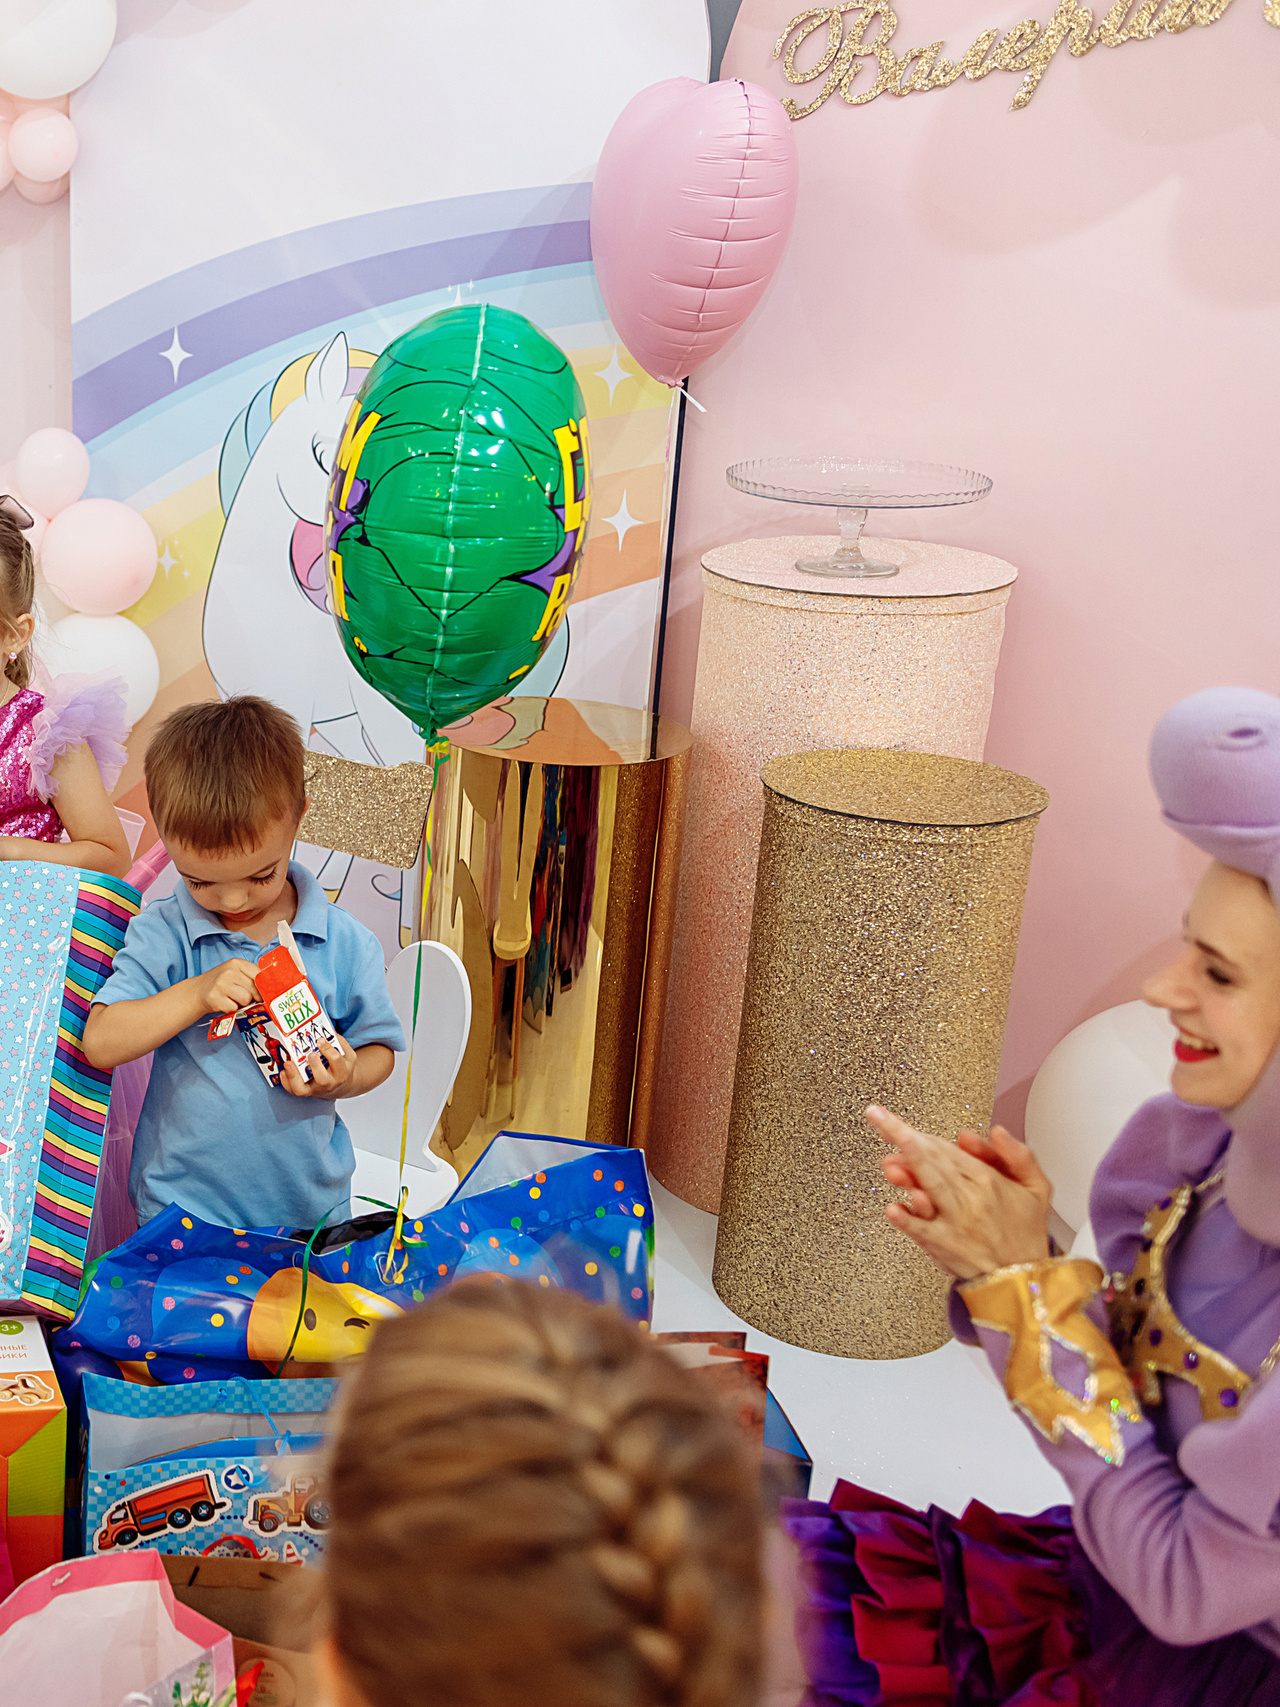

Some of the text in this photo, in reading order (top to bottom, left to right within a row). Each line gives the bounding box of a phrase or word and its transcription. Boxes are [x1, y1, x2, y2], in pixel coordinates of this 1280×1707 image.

[278, 989, 305, 1013] SWEET
[283, 1000, 315, 1030] BOX
[1, 1324, 18, 1332] 3+
